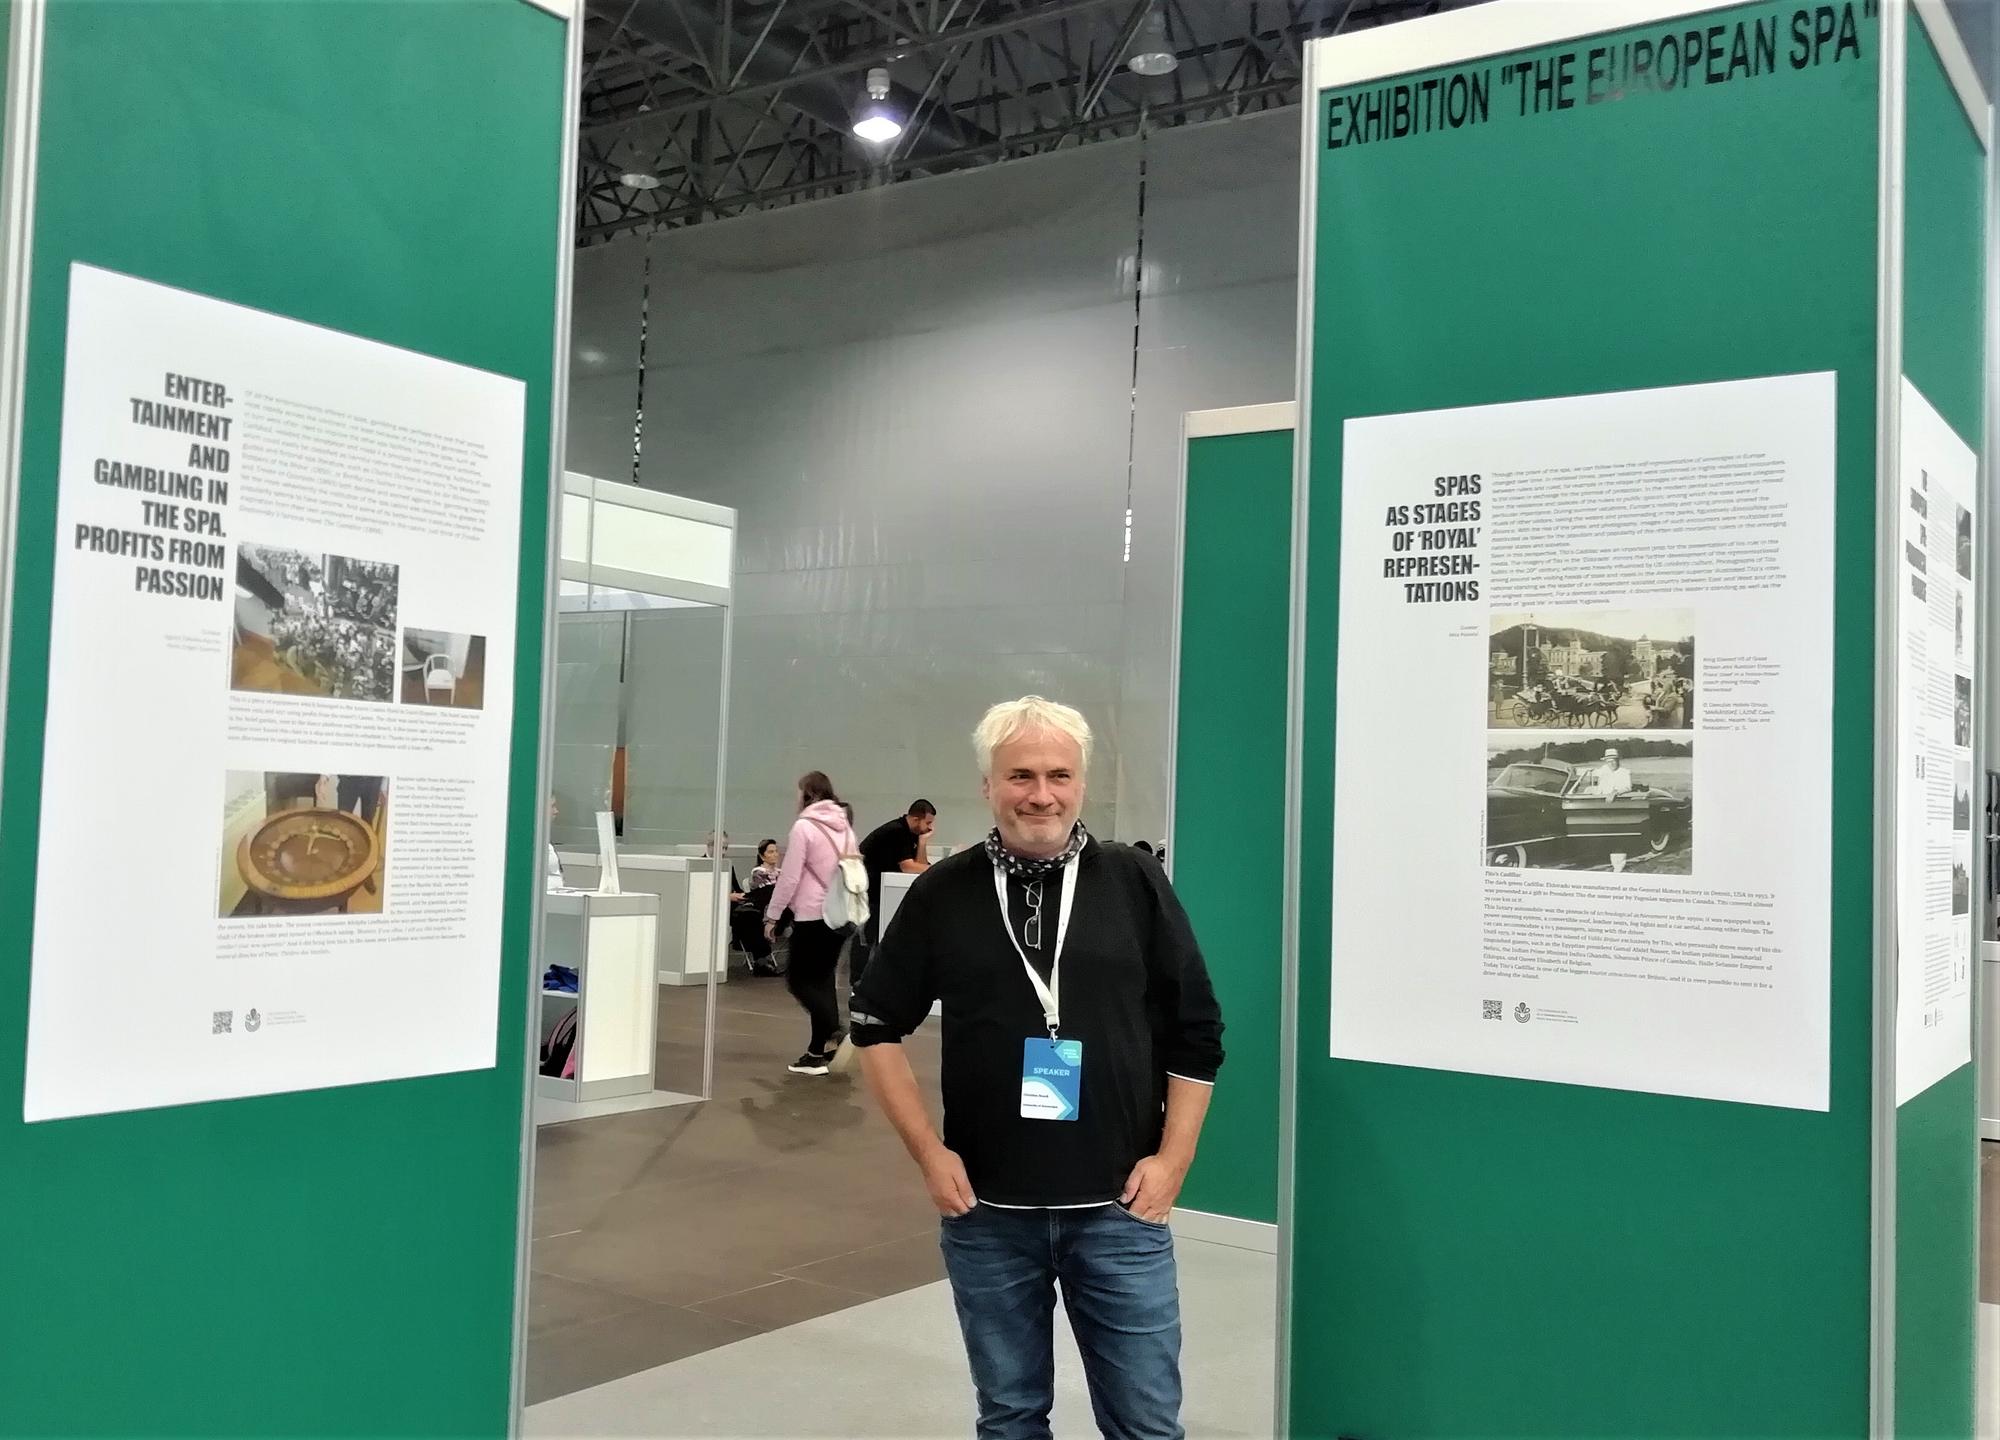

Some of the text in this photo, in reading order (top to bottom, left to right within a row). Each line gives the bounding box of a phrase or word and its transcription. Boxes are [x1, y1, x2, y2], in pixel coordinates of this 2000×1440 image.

[1327, 2, 1879, 149] EXHIBITION "THE EUROPEAN SPA"
[165, 372, 233, 409] ENTER-
[130, 397, 232, 441] TAINMENT
[188, 443, 230, 473] AND
[94, 458, 228, 505] GAMBLING IN
[1434, 474, 1481, 497] SPAS
[141, 500, 227, 537] THE SPA.
[1385, 500, 1481, 526] AS STAGES
[75, 524, 225, 570] PROFITS FROM
[1392, 531, 1414, 551] OF
[1383, 554, 1480, 578] REPRESEN-
[135, 566, 224, 601] PASSION
[1404, 580, 1479, 603] TATIONS
[1033, 1067, 1071, 1076] SPEAKER
